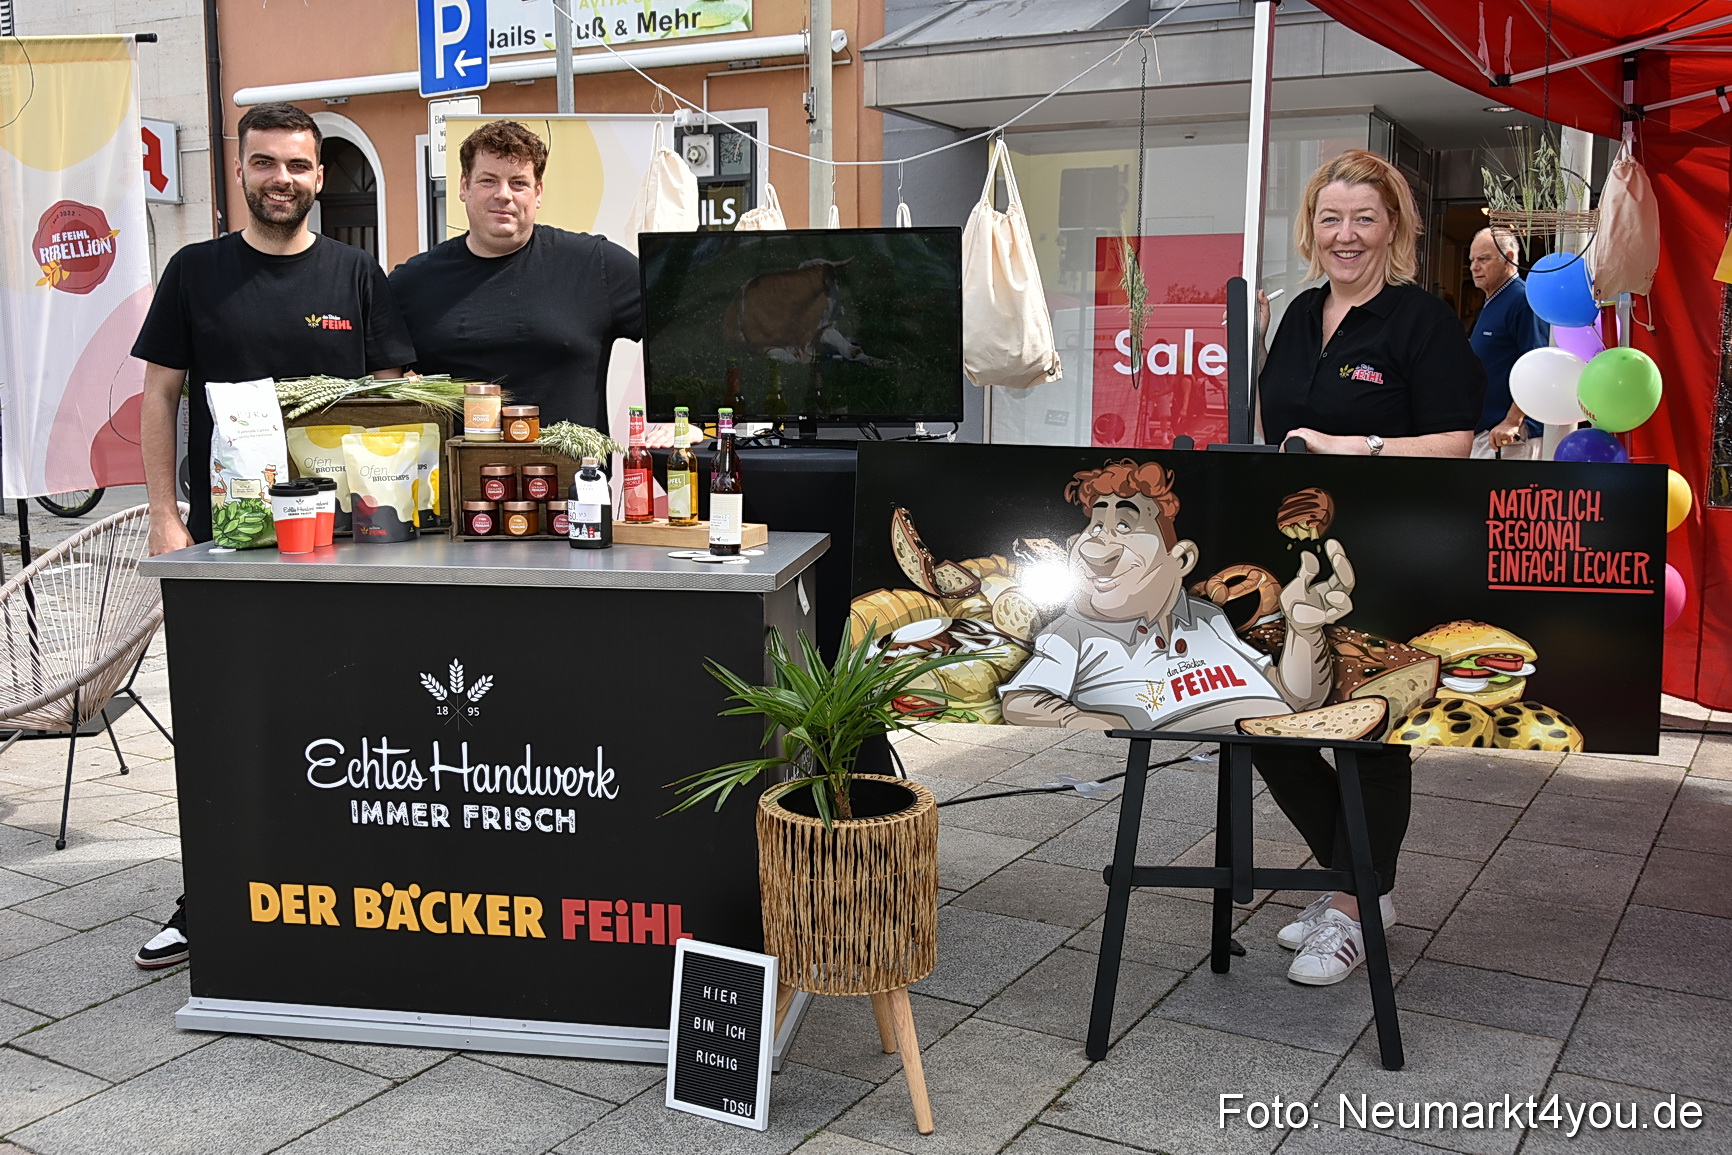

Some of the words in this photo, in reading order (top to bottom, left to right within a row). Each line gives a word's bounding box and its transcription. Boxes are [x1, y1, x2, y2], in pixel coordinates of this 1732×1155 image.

[615, 19, 628, 36] &
[636, 7, 702, 34] Mehr
[435, 0, 471, 79] P
[701, 198, 736, 226] ILS
[1113, 328, 1228, 376] Sale
[304, 457, 332, 470] Ofen
[315, 465, 346, 473] BROTCH
[360, 464, 388, 479] Ofen
[1489, 483, 1605, 522] NATÜRLICH.
[1485, 520, 1593, 552] REGIONAL.
[1487, 550, 1567, 584] EINFACH
[1573, 551, 1655, 585] LECKER.
[436, 705, 449, 716] 18
[467, 706, 480, 718] 95
[304, 736, 428, 790] Echtes
[428, 740, 620, 800] Handwerk
[351, 800, 451, 829] IMMER
[463, 804, 577, 834] FRISCH
[248, 881, 341, 926] DER
[353, 881, 547, 939] BÄCKER
[703, 985, 737, 1005] HIER
[693, 1017, 714, 1033] BIN
[725, 1024, 746, 1041] ICH
[696, 1050, 738, 1071] RICHIG
[722, 1098, 752, 1117] TDSU
